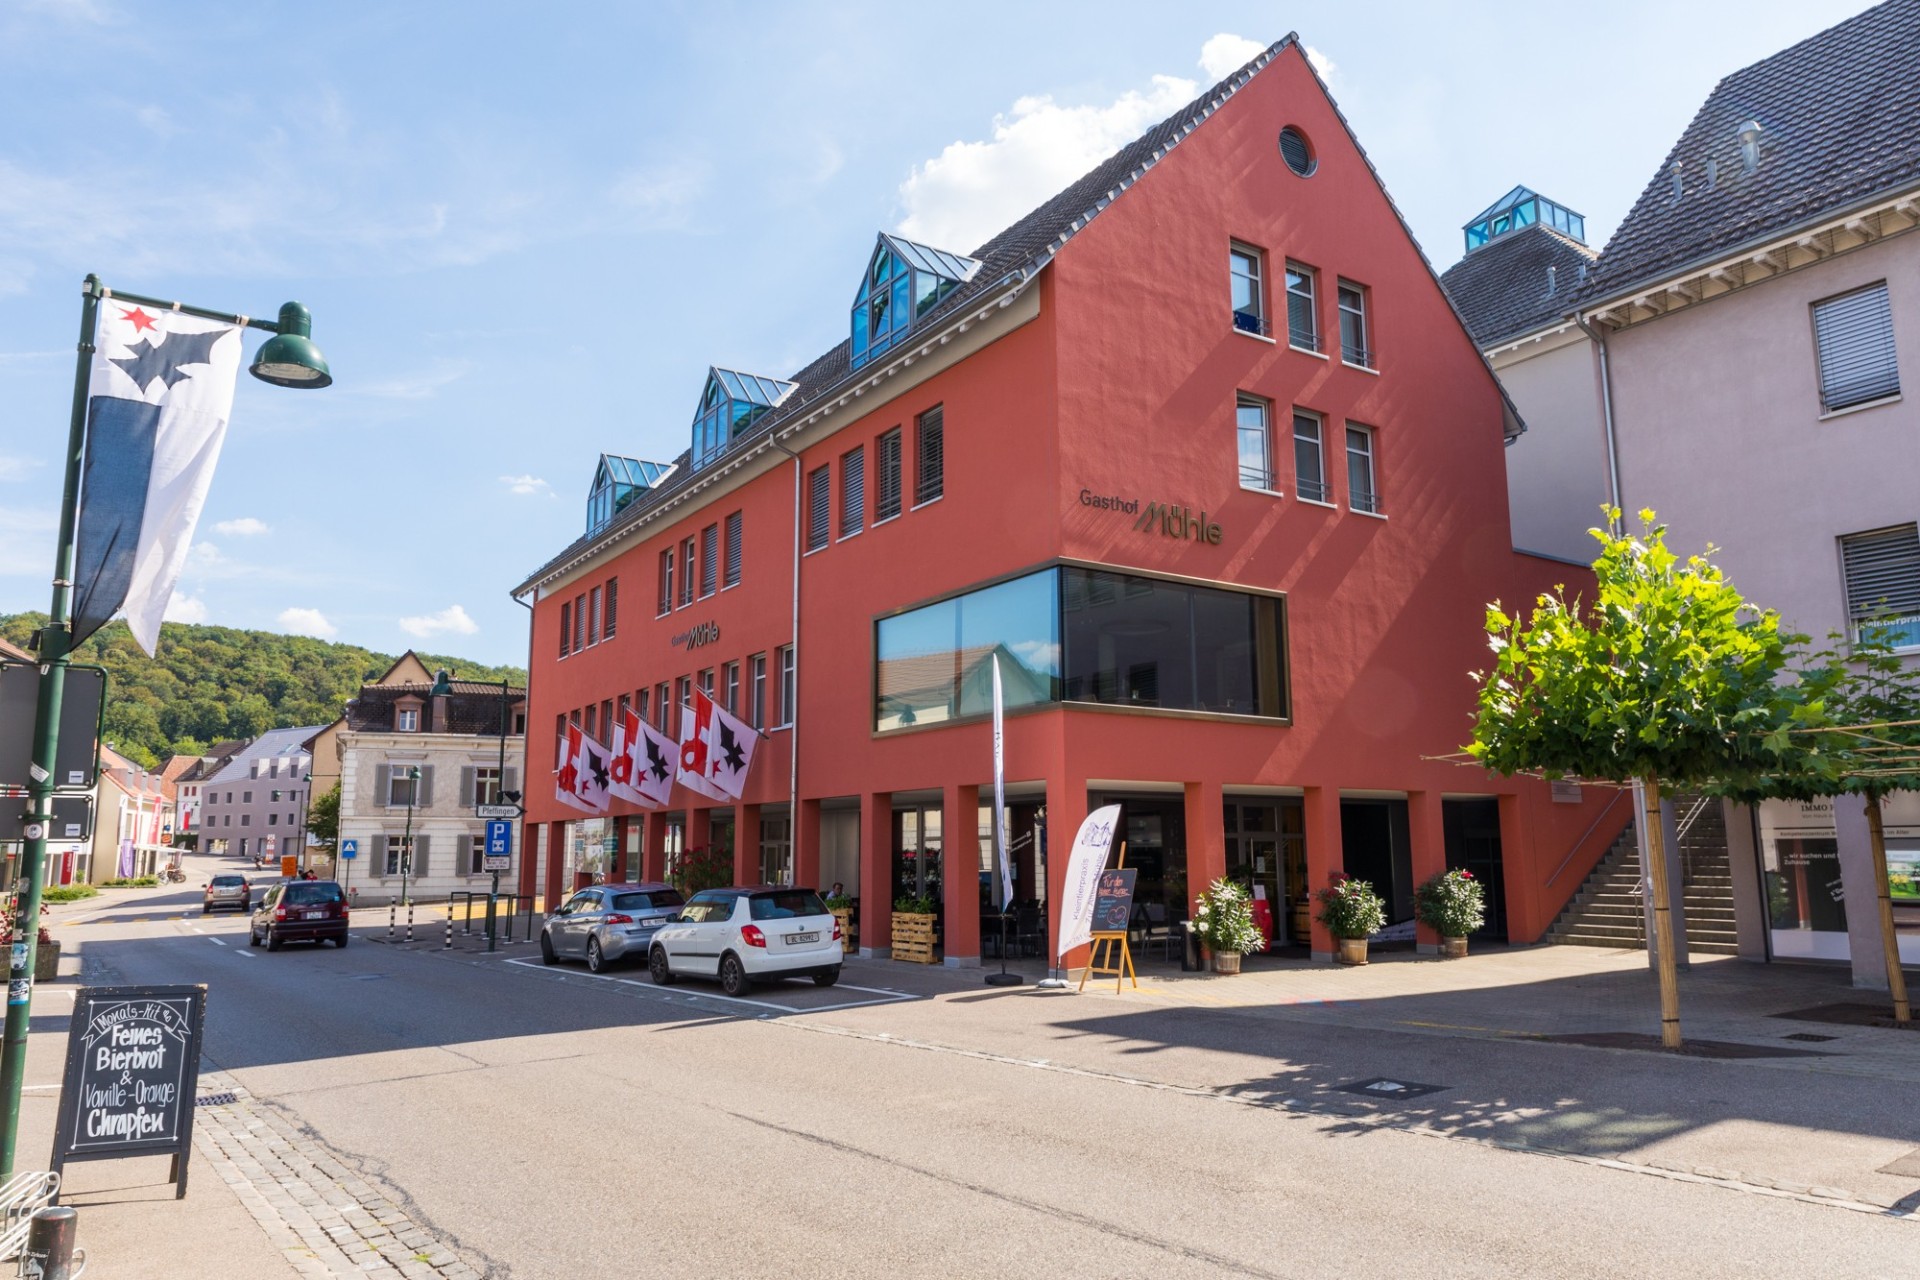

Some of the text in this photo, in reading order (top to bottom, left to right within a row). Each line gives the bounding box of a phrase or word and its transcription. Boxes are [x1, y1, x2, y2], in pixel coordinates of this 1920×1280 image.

[1079, 488, 1223, 545] Gasthof Mühle
[686, 620, 720, 651] Mühle
[482, 807, 514, 816] Pfeffingen
[1801, 804, 1828, 812] IMMO
[494, 824, 504, 840] P
[1073, 858, 1089, 920] Kleintierpraxis
[96, 1003, 162, 1030] Monats-Hit
[111, 1022, 162, 1047] Feines
[96, 1044, 166, 1072] Bierbrot
[120, 1070, 133, 1086] &
[86, 1080, 175, 1108] Vanille-Orange
[86, 1106, 164, 1140] Chrapfen
